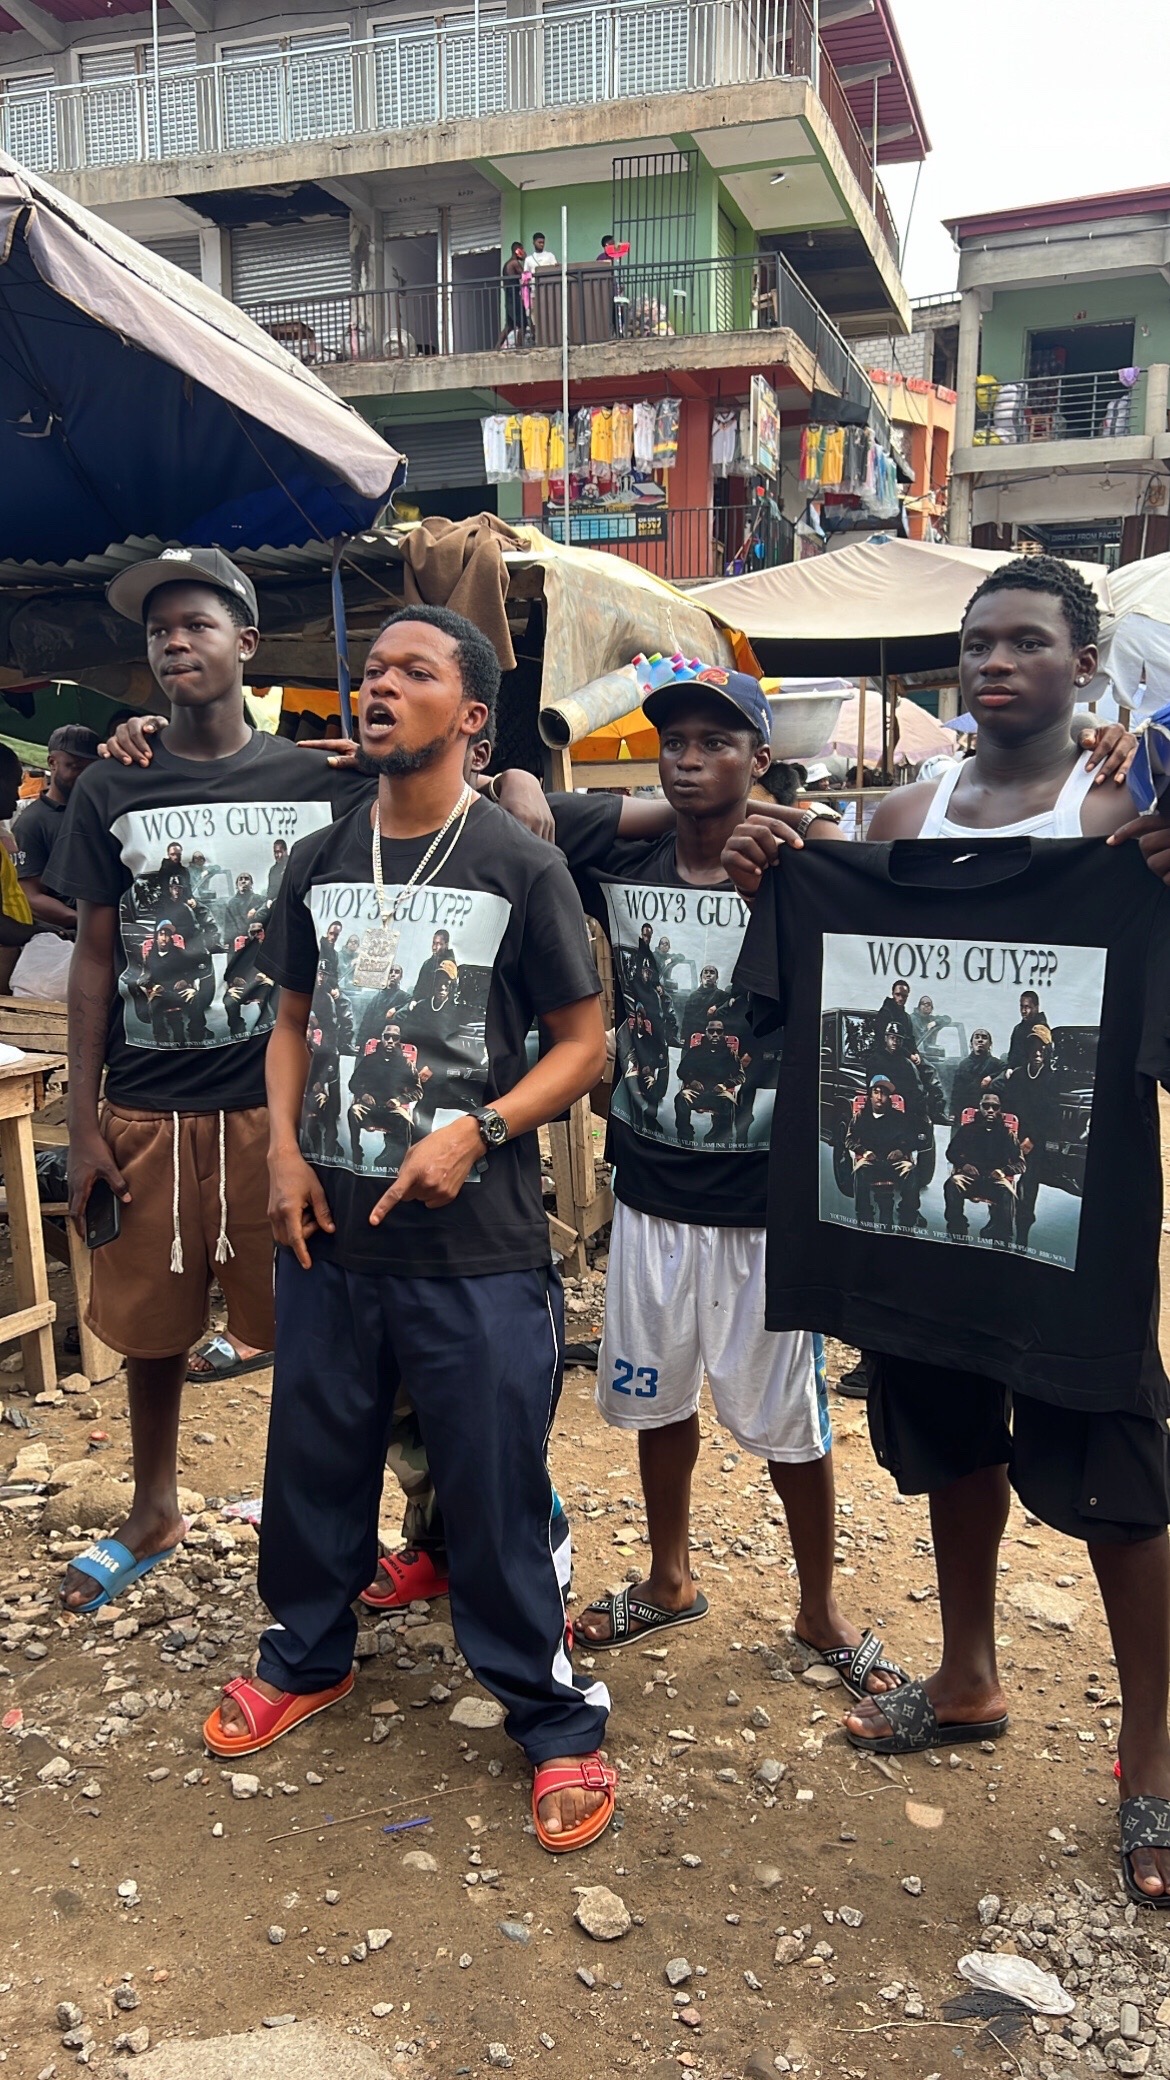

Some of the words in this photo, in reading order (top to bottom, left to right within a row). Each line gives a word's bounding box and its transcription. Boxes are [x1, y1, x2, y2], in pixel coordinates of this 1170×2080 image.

[1051, 533, 1076, 542] DIRECT
[1077, 532, 1098, 541] FROM
[141, 808, 215, 842] WOY3
[226, 806, 298, 836] GUY???
[319, 888, 382, 920] WOY3
[393, 891, 473, 927] GUY???
[624, 889, 687, 924] WOY3
[866, 941, 951, 980] WOY3
[963, 946, 1058, 987] GUY???
[612, 1357, 659, 1398] 23
